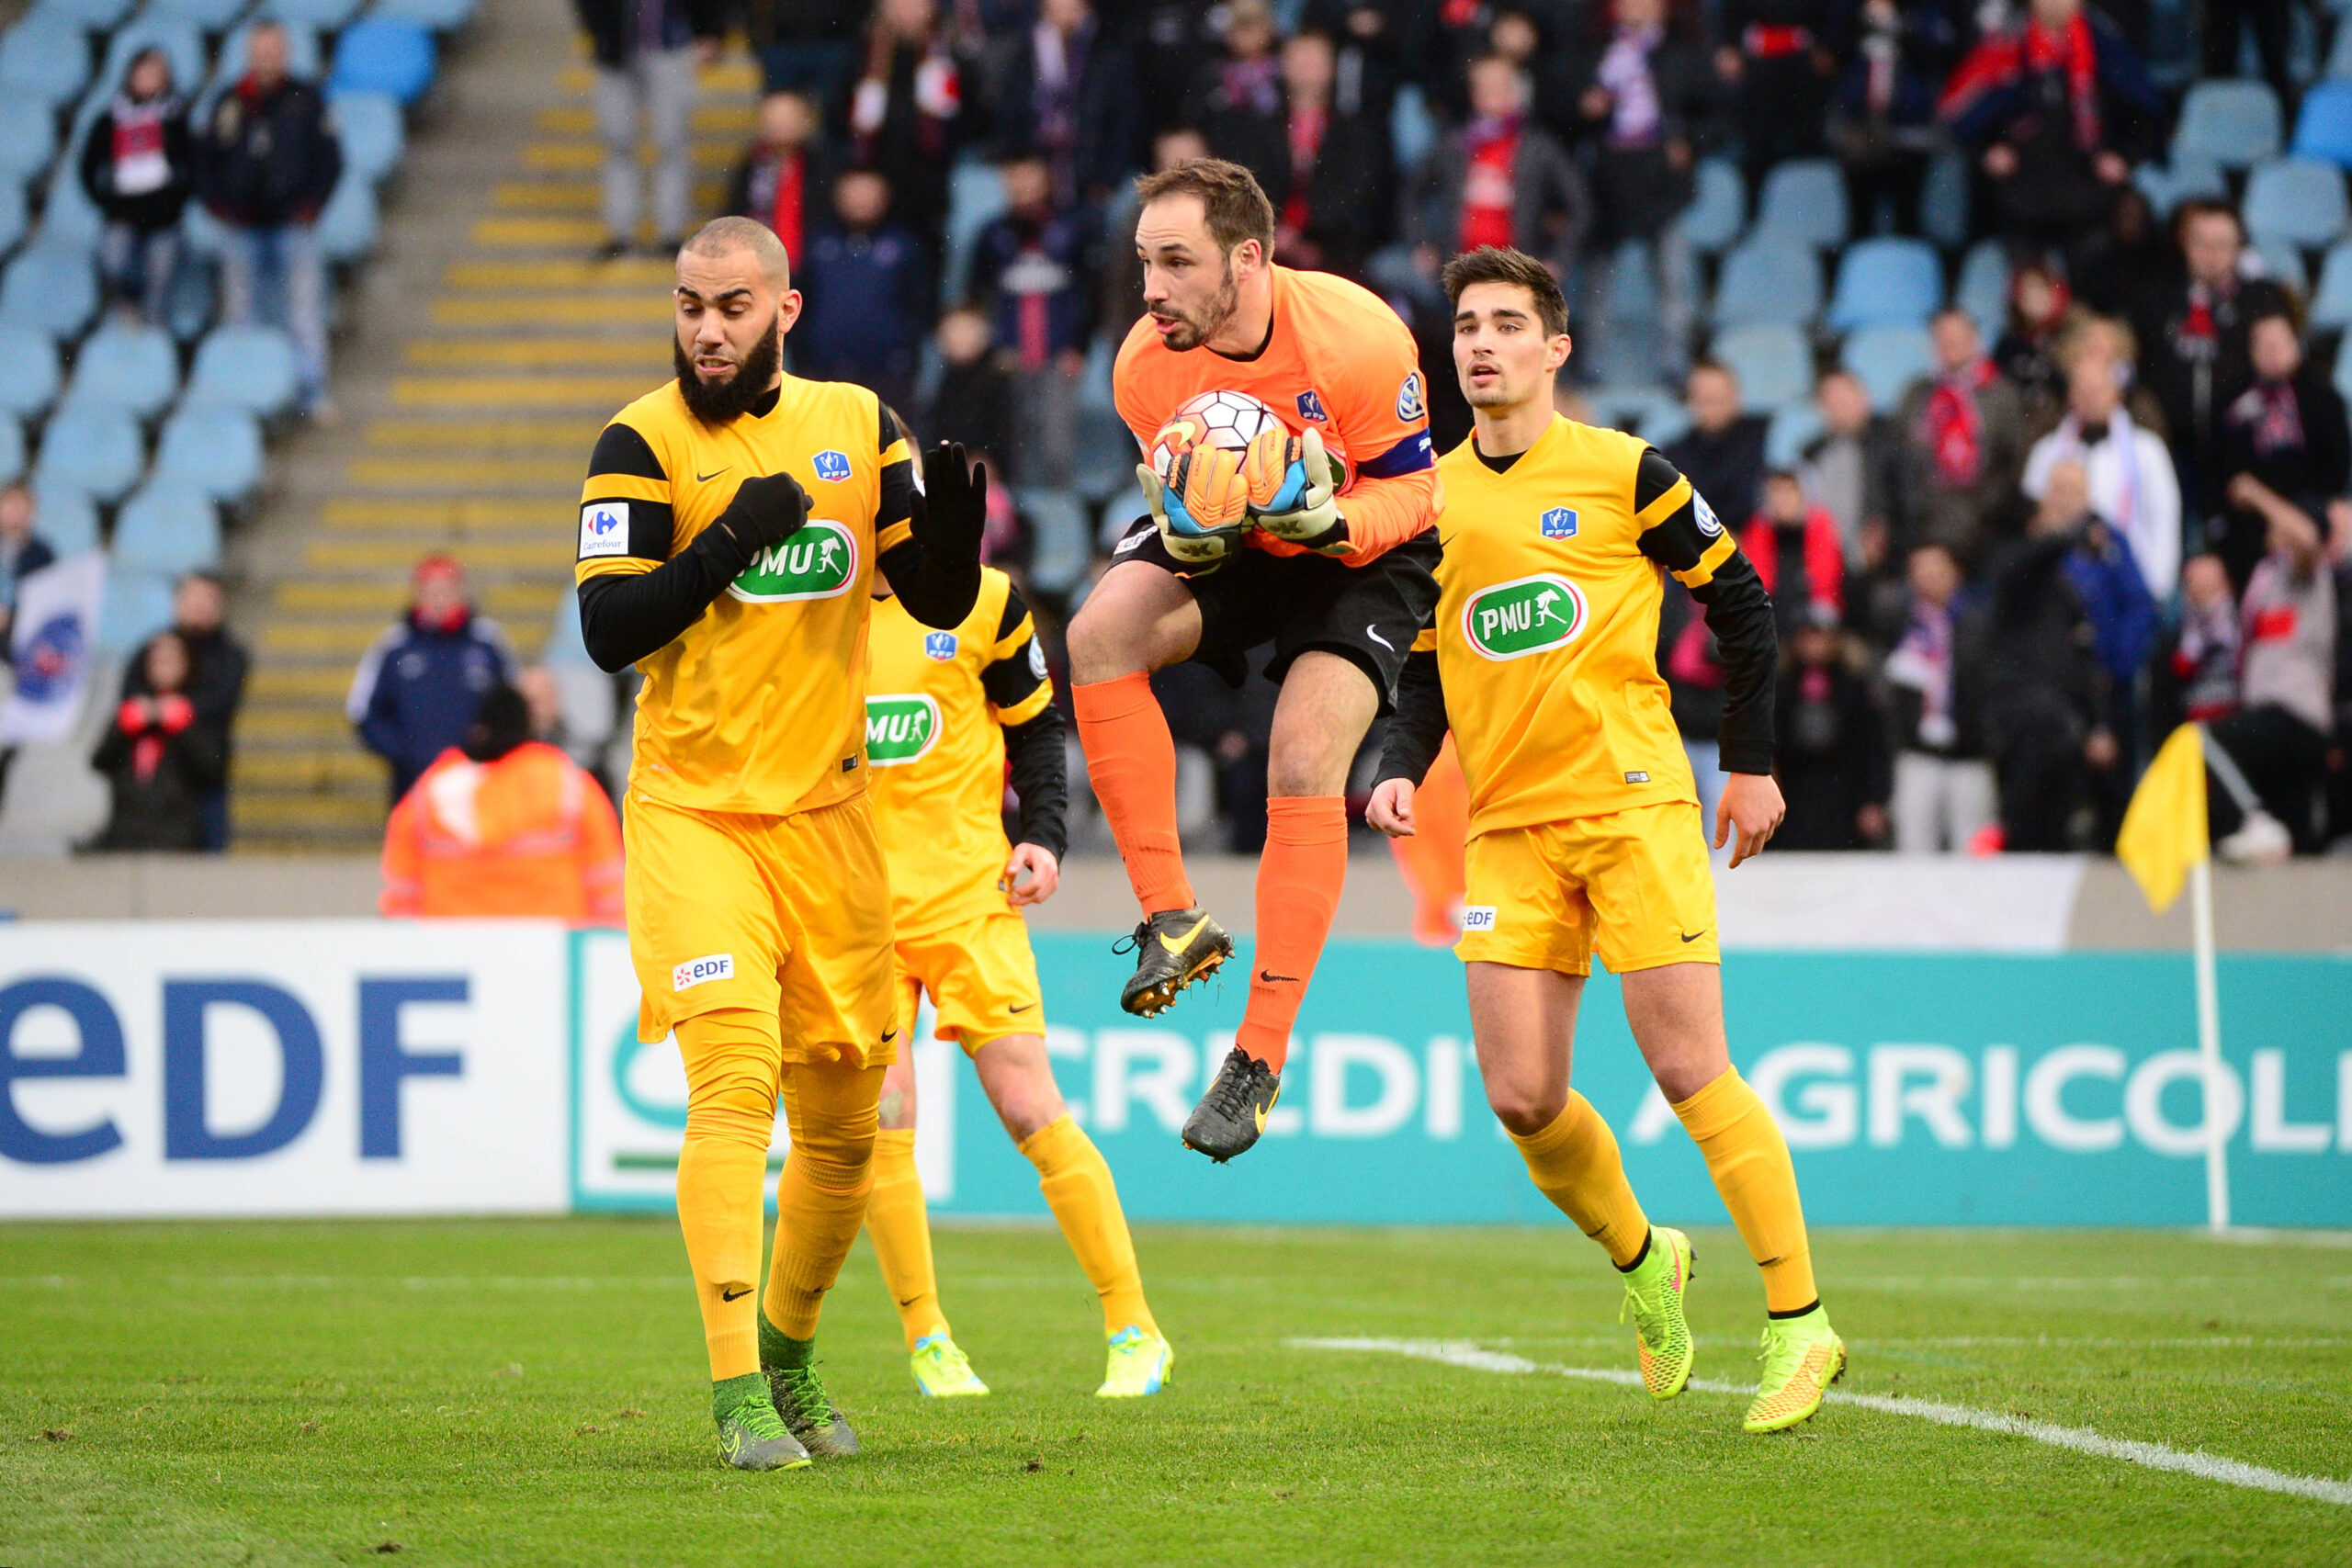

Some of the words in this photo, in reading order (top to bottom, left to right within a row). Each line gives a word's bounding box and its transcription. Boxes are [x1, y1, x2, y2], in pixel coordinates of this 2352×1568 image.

[583, 539, 621, 550] Carrefour
[1478, 599, 1531, 640] PMU
[865, 715, 911, 743] MU
[694, 960, 729, 978] eDF
[0, 975, 471, 1164] eDF
[1628, 1043, 2352, 1155] GRICOL
